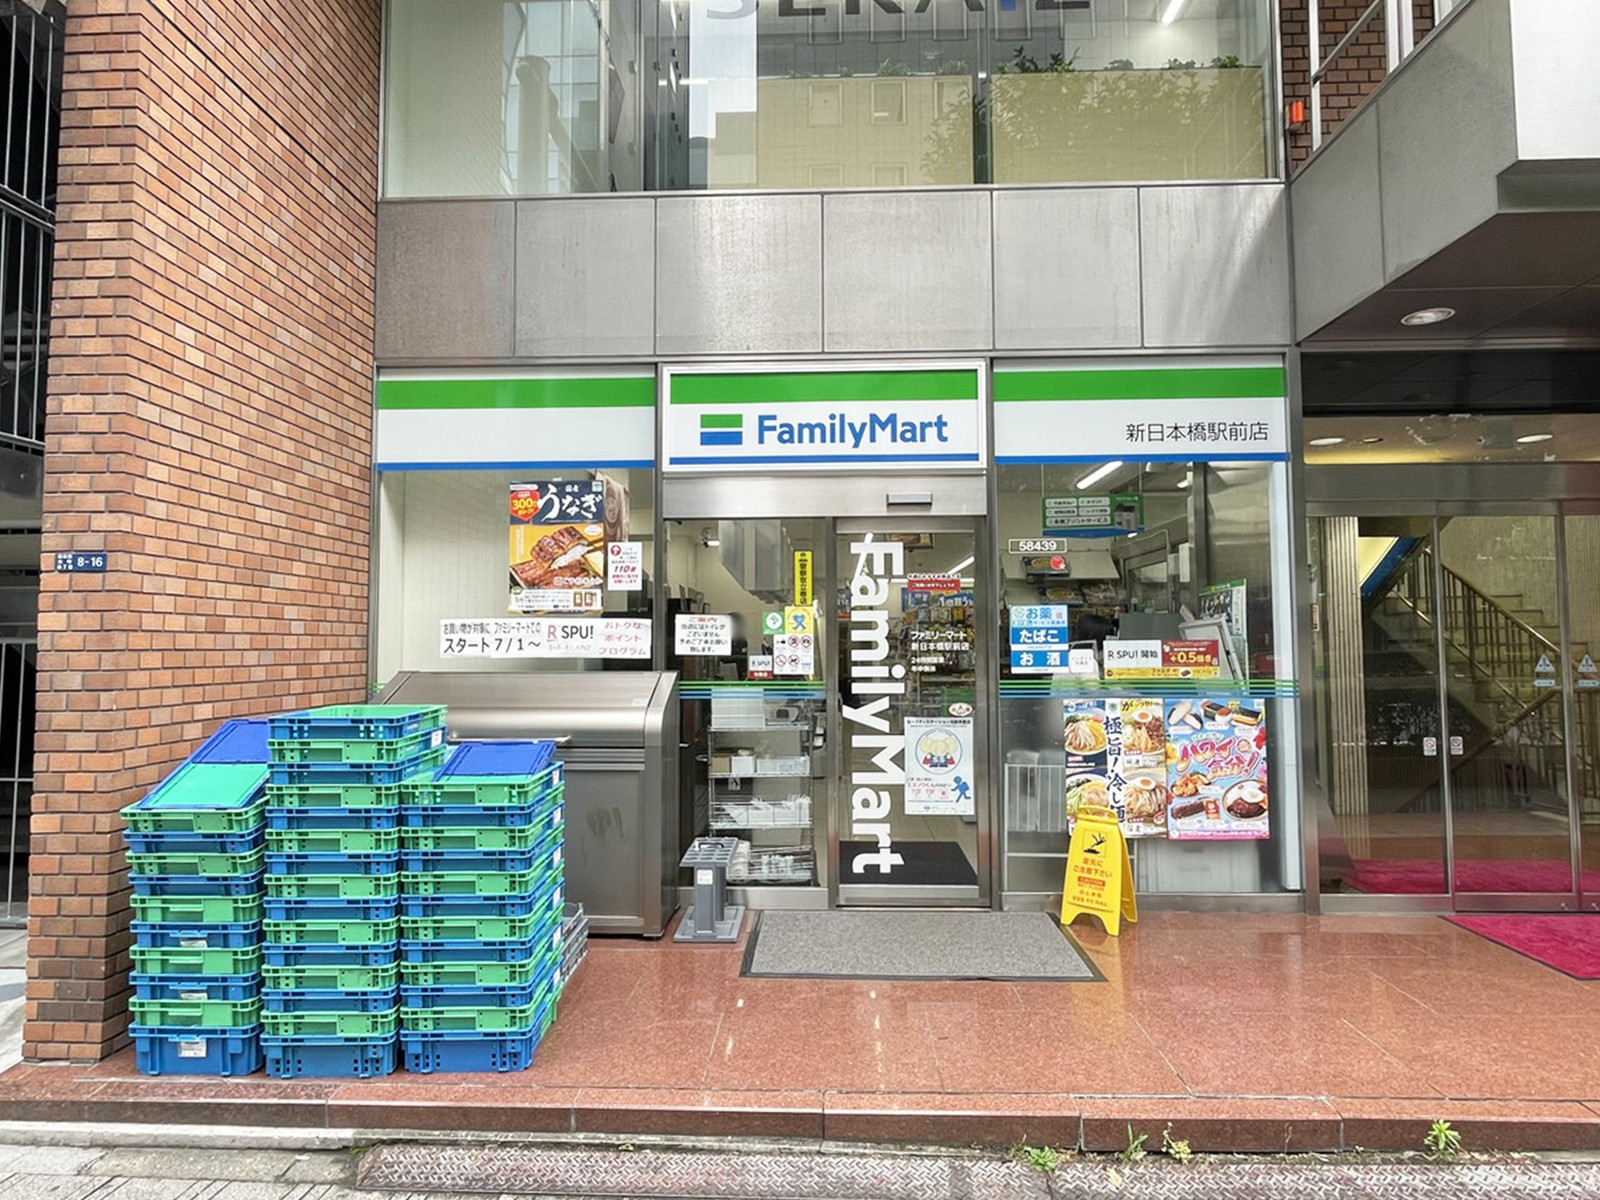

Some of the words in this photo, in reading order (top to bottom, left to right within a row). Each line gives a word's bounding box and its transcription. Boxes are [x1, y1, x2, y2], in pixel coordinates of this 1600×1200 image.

[757, 413, 948, 449] FamilyMart
[1125, 422, 1269, 443] 新日本橋駅前店
[538, 483, 603, 522] うなぎ
[1018, 540, 1057, 551] 58439
[77, 556, 103, 567] 8-16
[1026, 607, 1052, 620] お薬
[561, 625, 594, 640] SPU!
[604, 634, 642, 642] ポイント
[911, 630, 967, 640] ファミリーマート
[1019, 629, 1060, 643] たばこ
[444, 637, 490, 653] スタート
[598, 646, 647, 655] プログラム
[842, 541, 906, 874] FamilyMart
[1176, 738, 1236, 773] ハワイ
